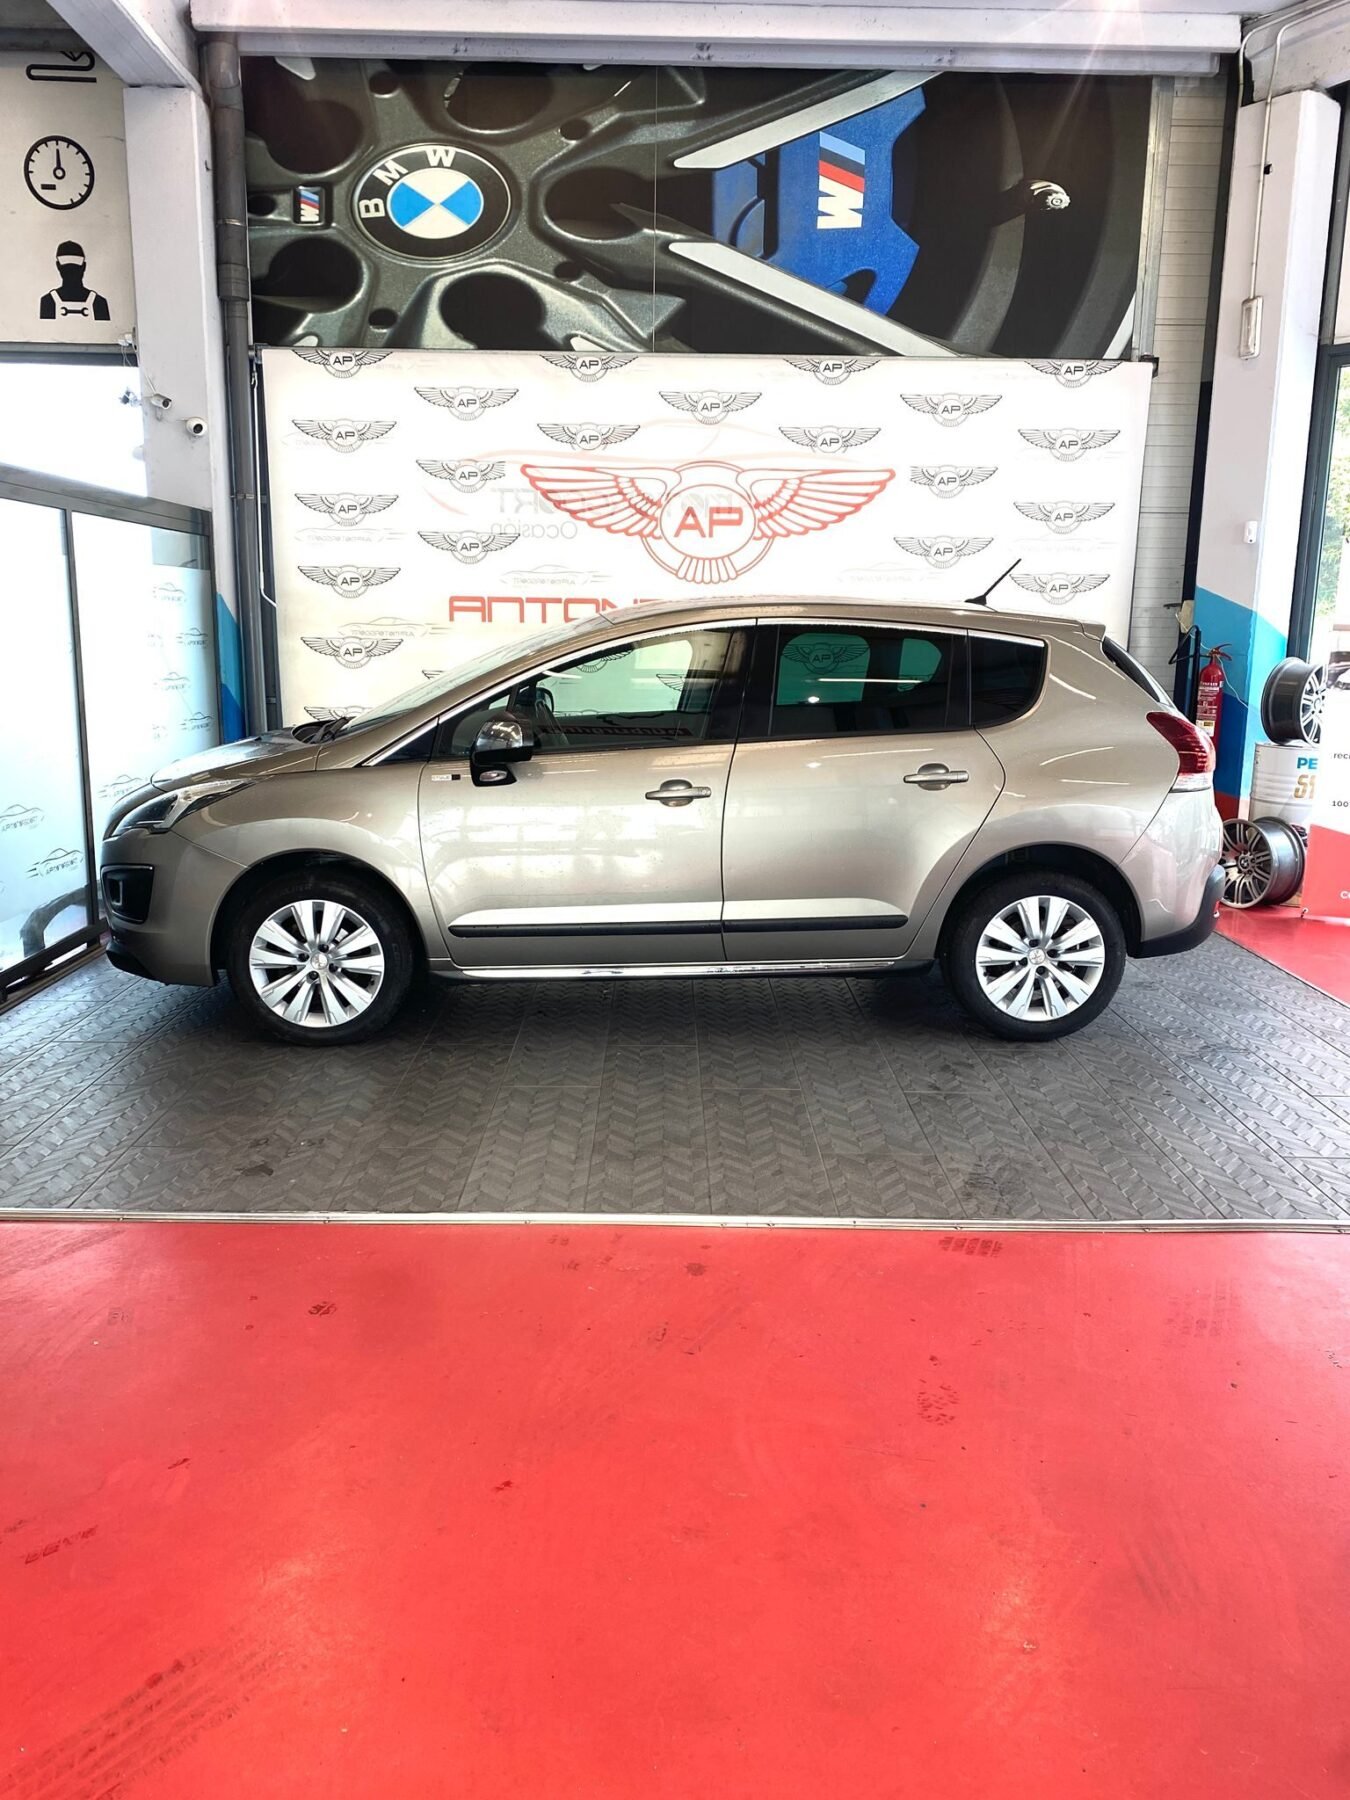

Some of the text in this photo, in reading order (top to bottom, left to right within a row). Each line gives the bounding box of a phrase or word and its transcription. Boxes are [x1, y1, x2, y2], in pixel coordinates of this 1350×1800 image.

[358, 148, 457, 219] BMW
[333, 356, 352, 365] AP
[580, 360, 599, 369] AP
[823, 363, 842, 372] AP
[1064, 366, 1084, 375] AP
[458, 398, 477, 407] AP
[701, 402, 720, 411] AP
[942, 405, 961, 414] AP
[336, 431, 355, 440] AP
[580, 435, 599, 444] AP
[820, 438, 839, 447] AP
[1059, 440, 1078, 449] AP
[459, 471, 478, 480] AP
[938, 477, 957, 485] AP
[338, 505, 357, 513] AP
[1054, 513, 1073, 521] AP
[674, 506, 744, 538] AP
[460, 543, 479, 551] AP
[934, 548, 953, 556] AP
[341, 577, 360, 585] AP
[1050, 584, 1069, 592] AP
[344, 648, 363, 656] AP
[812, 654, 831, 662] AP
